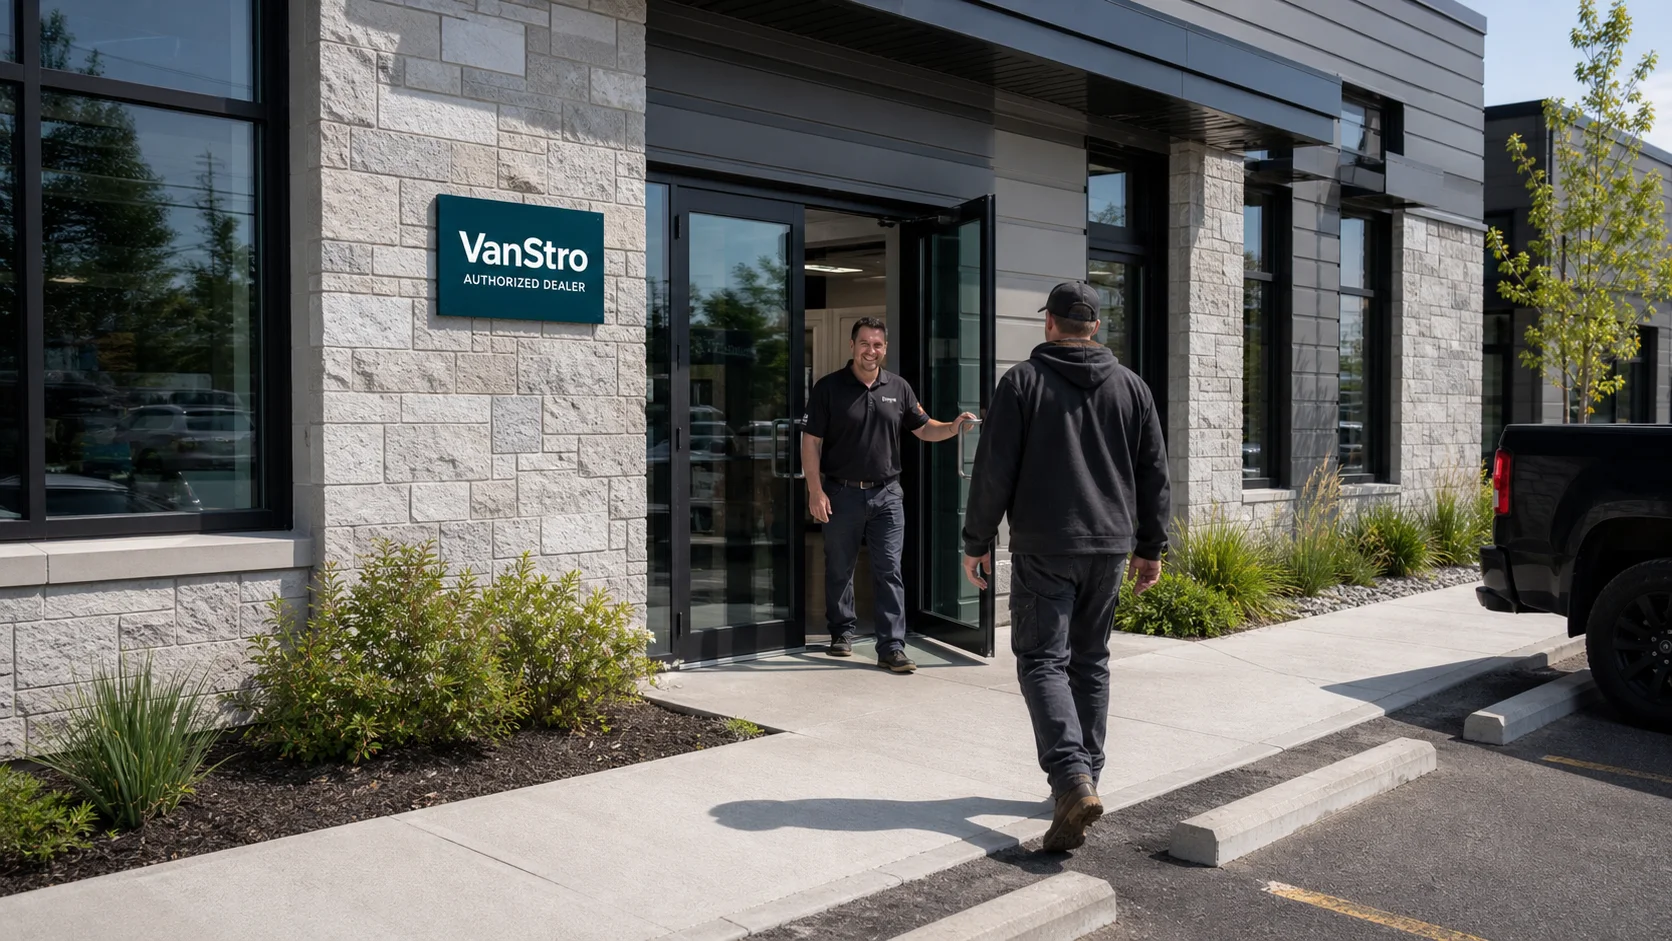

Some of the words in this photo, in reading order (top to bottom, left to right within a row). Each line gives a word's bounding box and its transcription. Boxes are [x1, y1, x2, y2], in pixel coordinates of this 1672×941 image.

[458, 230, 588, 272] VanStro
[463, 273, 540, 289] AUTHORIZED
[543, 279, 586, 293] DEALER
